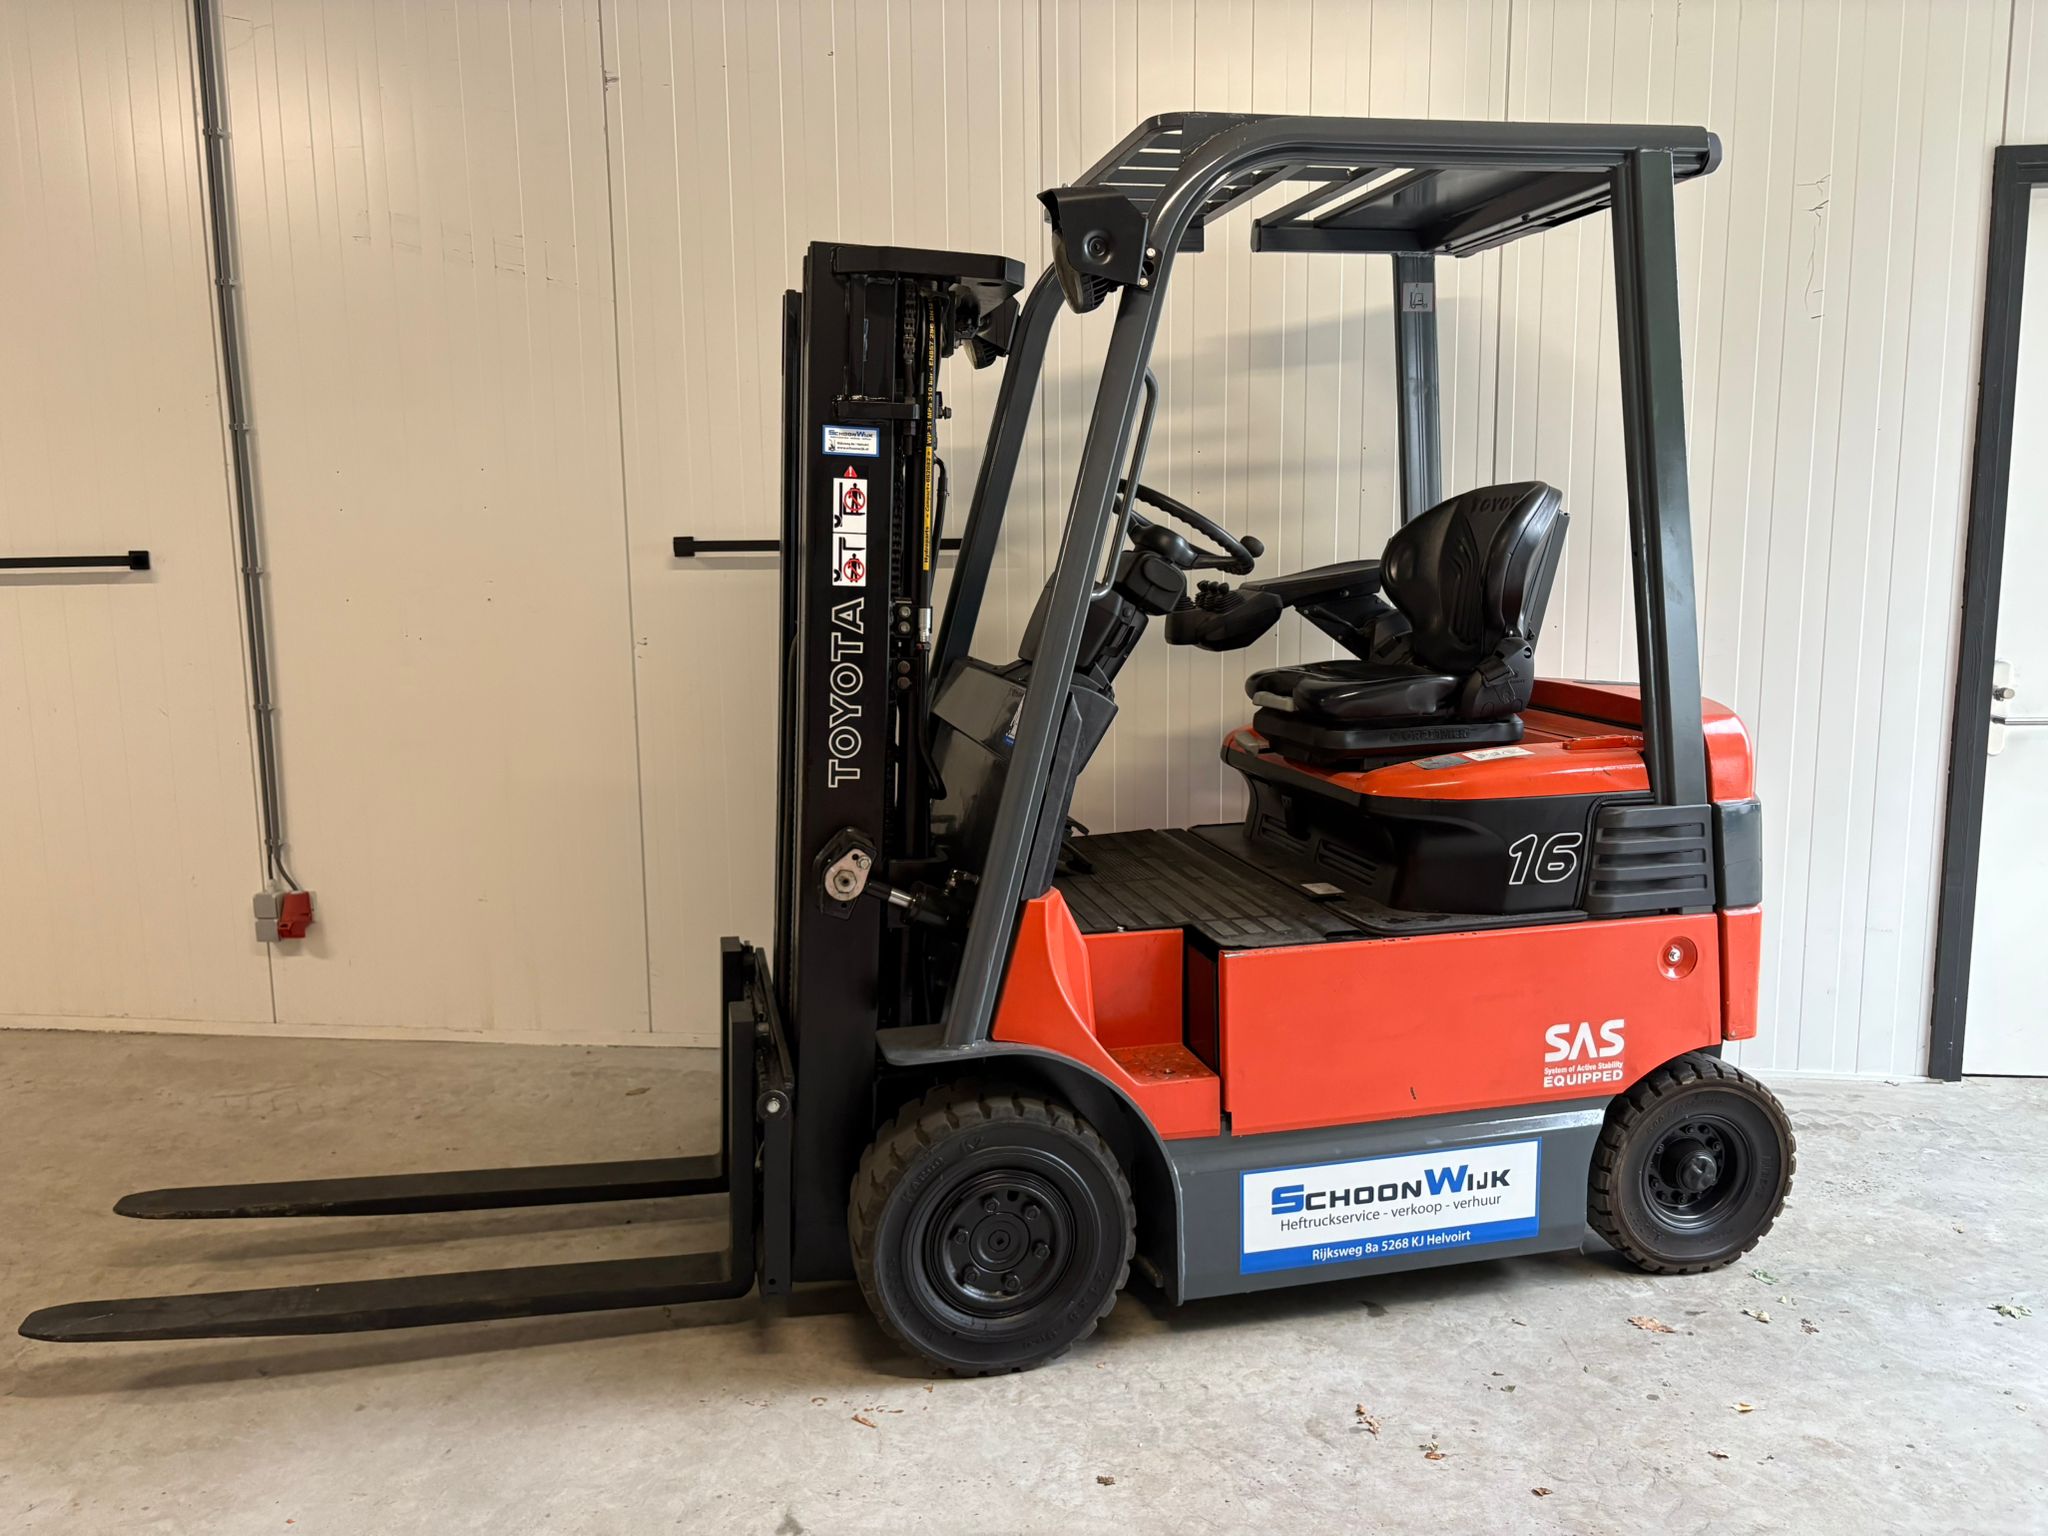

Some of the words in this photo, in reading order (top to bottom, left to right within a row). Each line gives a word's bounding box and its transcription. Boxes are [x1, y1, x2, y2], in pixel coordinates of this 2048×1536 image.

[828, 597, 865, 788] TOYOTA
[1508, 832, 1583, 885] 16
[1544, 1018, 1625, 1063] SAS
[1543, 1069, 1624, 1088] EQUIPPED
[1544, 1066, 1568, 1076] System
[1568, 1065, 1576, 1073] of
[1576, 1063, 1597, 1072] Active
[1598, 1060, 1624, 1070] Stability
[1280, 1210, 1380, 1232] Heftruckservice
[1391, 1202, 1442, 1218] verkoop
[1452, 1194, 1502, 1210] verhuur
[1312, 1244, 1362, 1262] Rijksweg
[1365, 1242, 1378, 1254] 8a
[1382, 1238, 1409, 1252] 5268
[1412, 1236, 1424, 1248] KJ
[1426, 1230, 1471, 1245] Helvoirt
